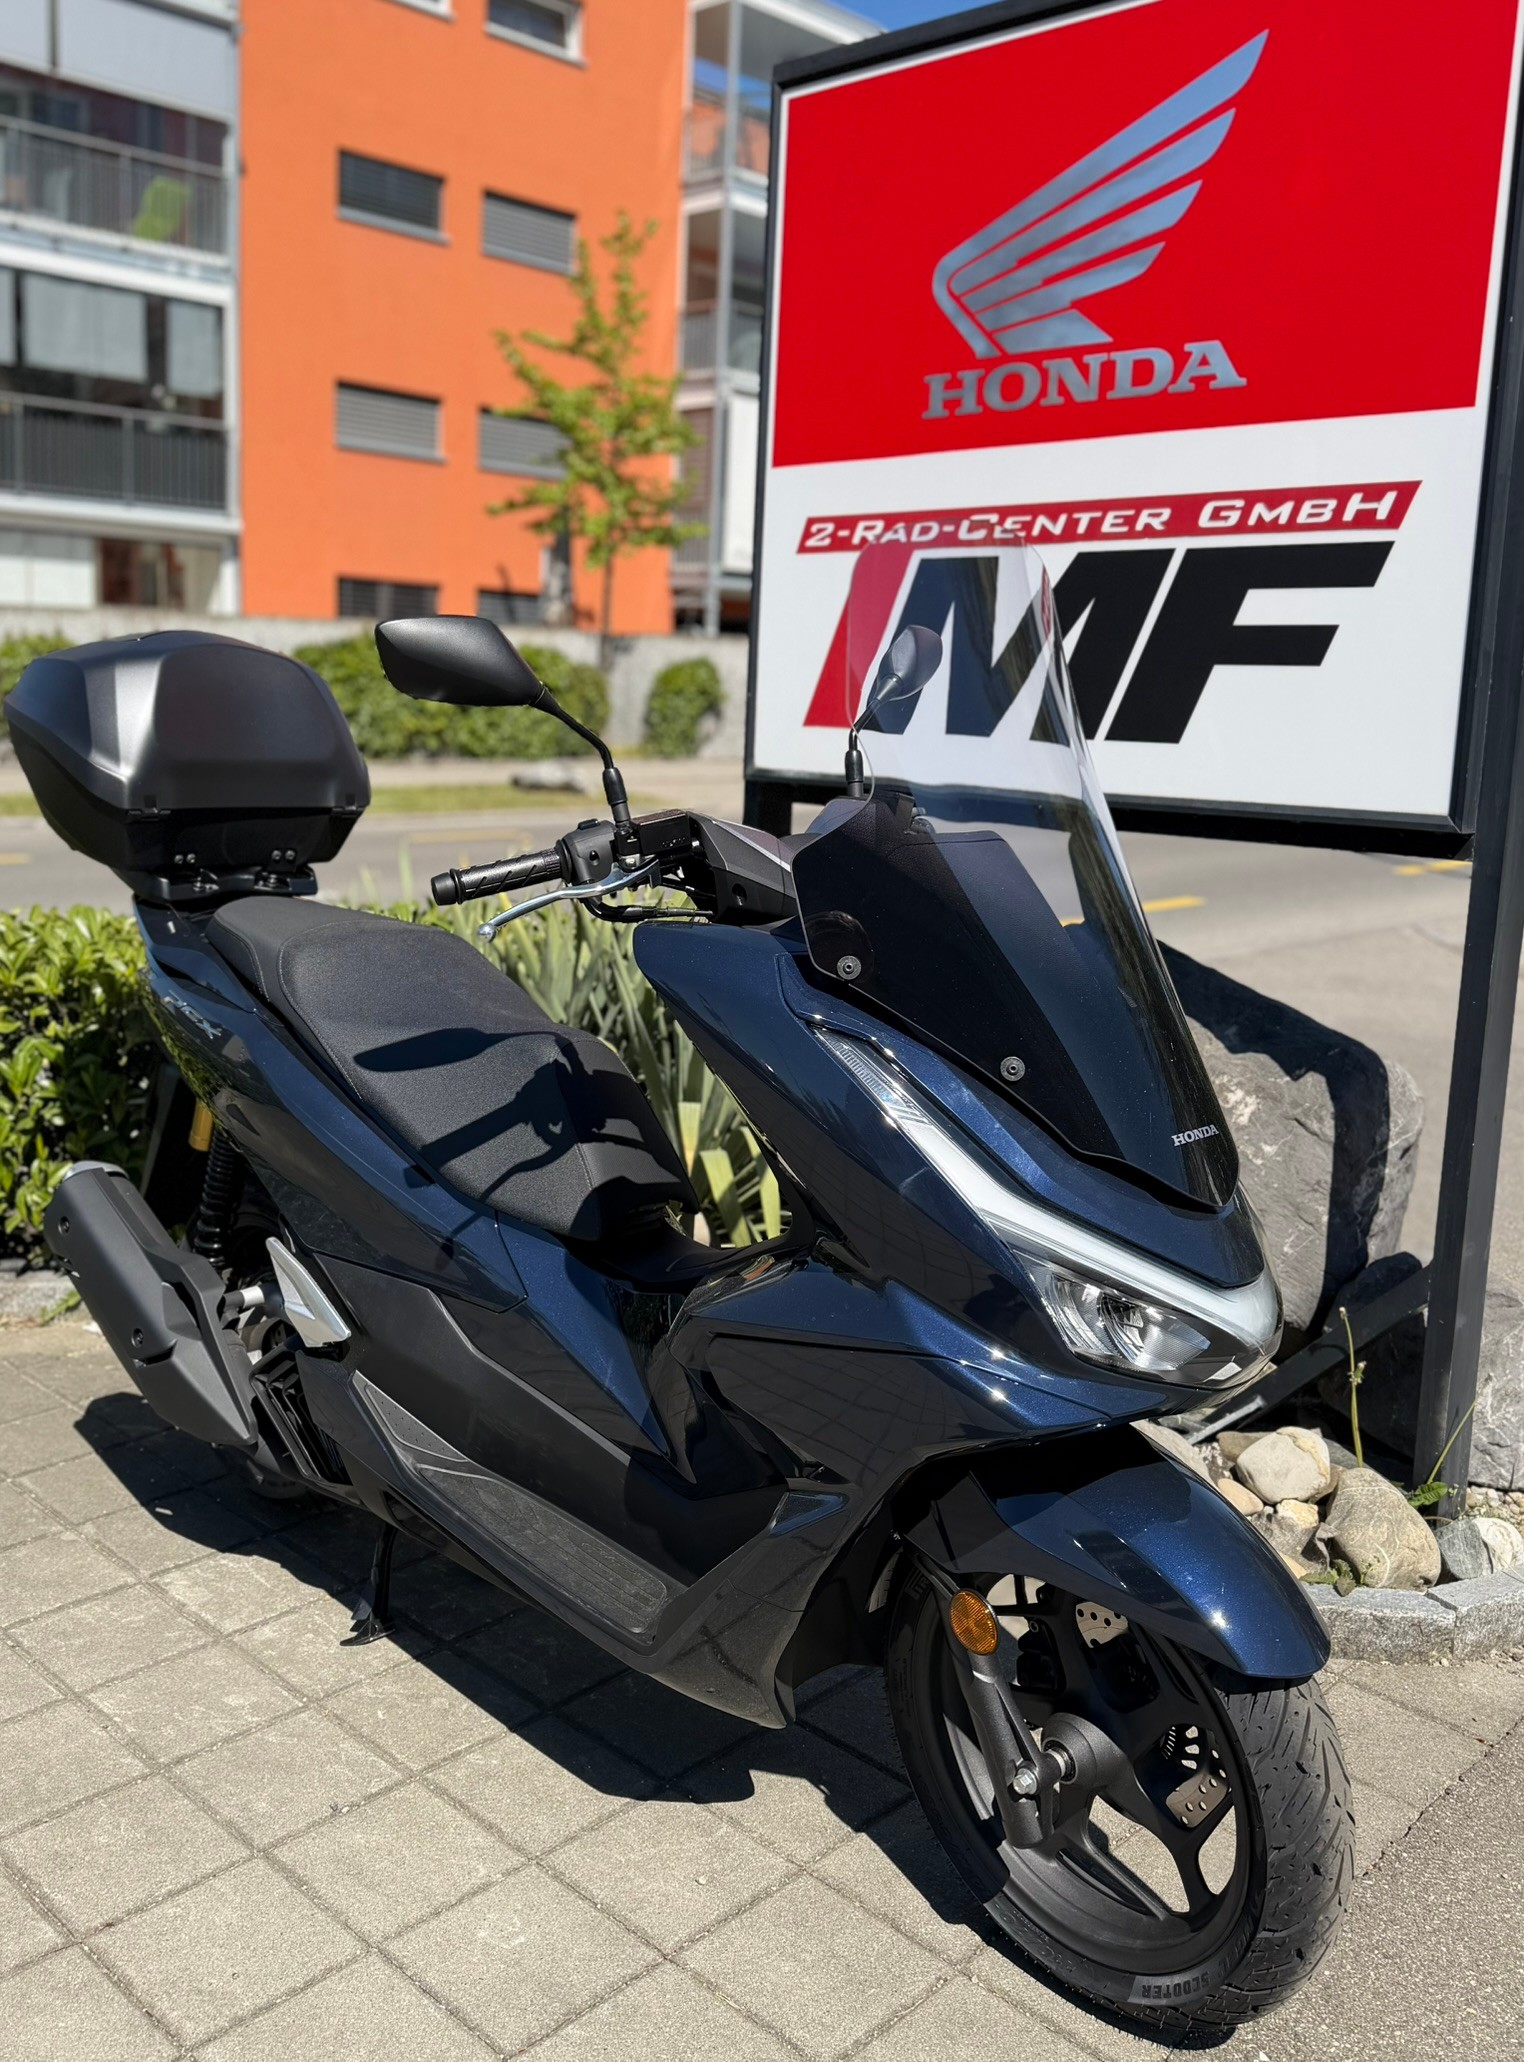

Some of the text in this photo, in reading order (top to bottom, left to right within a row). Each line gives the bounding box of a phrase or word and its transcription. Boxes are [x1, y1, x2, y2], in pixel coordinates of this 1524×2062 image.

[922, 340, 1247, 419] HONDA
[797, 535, 1396, 744] TMF
[1171, 1124, 1219, 1147] HONDA
[1141, 1971, 1211, 1999] SCOOTER
